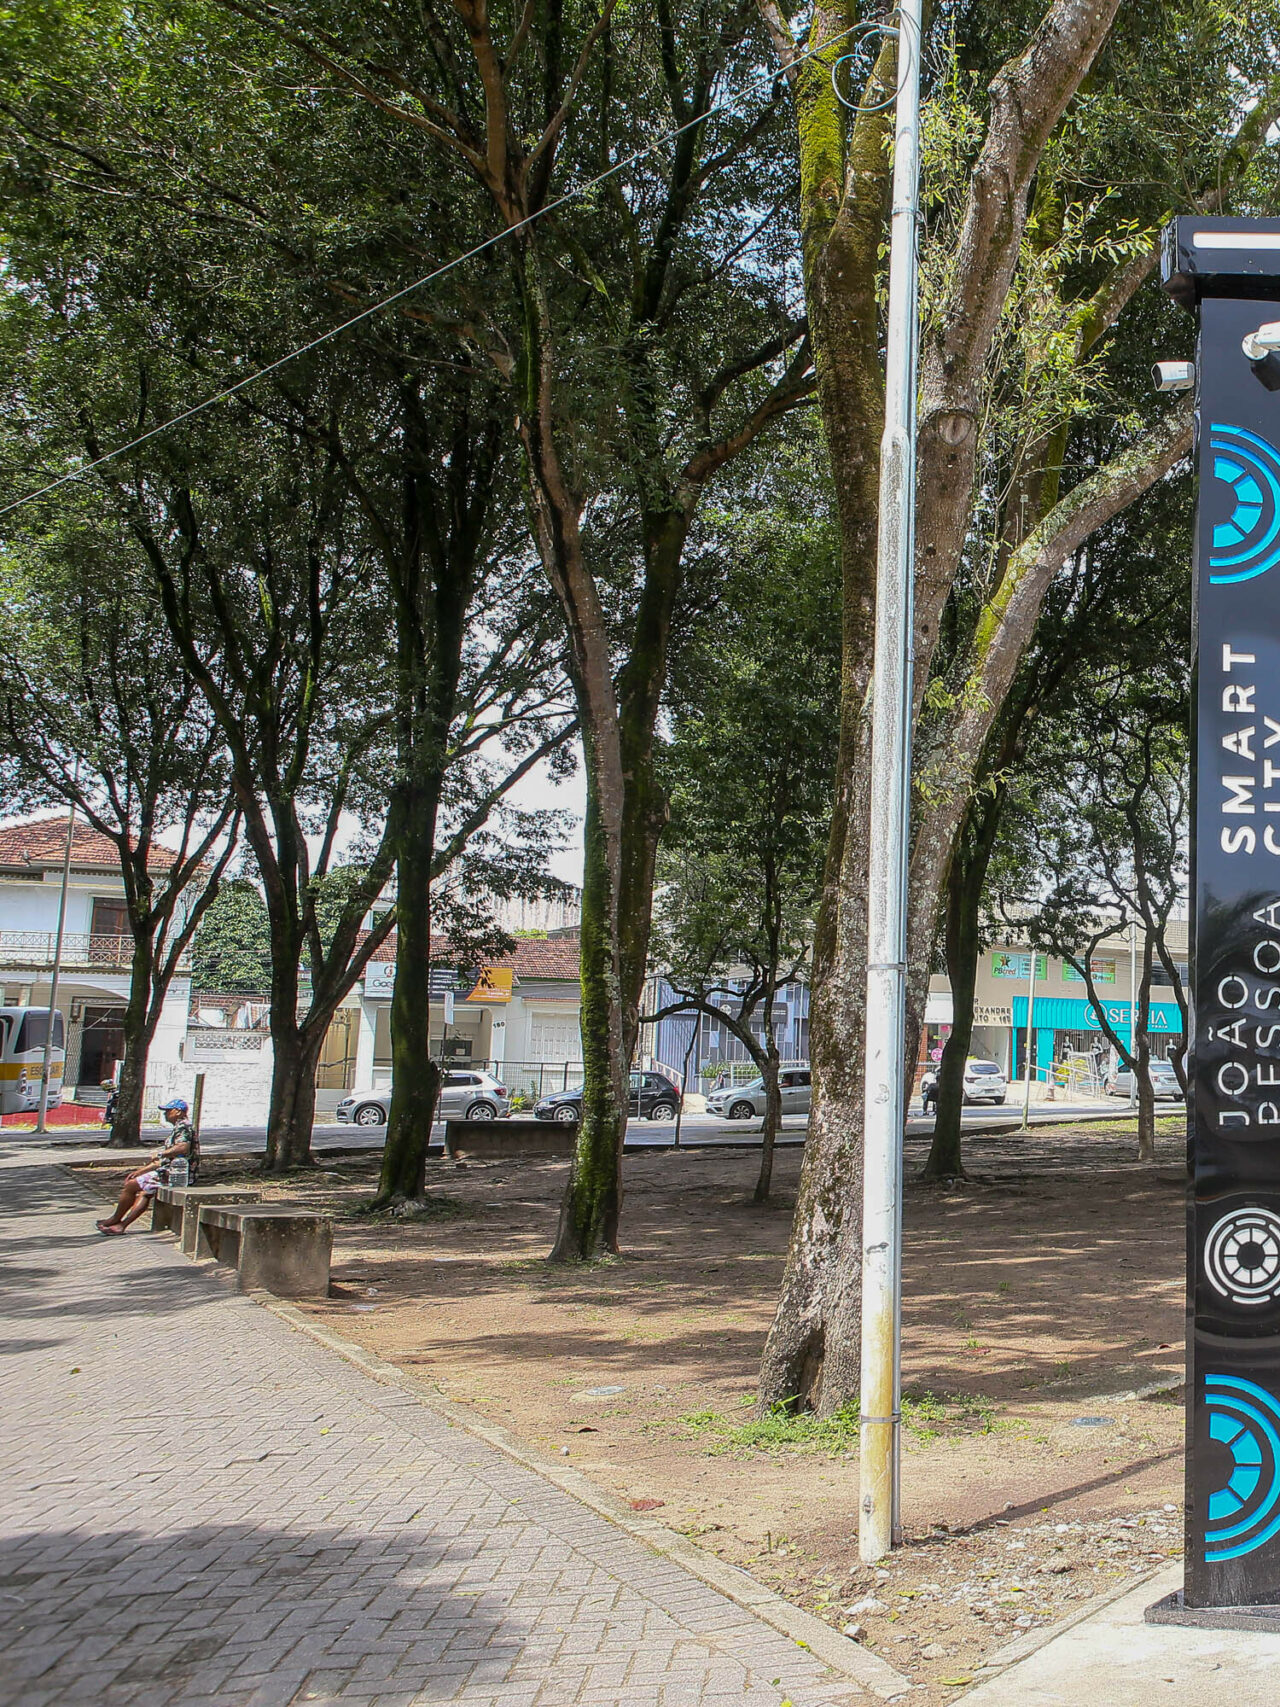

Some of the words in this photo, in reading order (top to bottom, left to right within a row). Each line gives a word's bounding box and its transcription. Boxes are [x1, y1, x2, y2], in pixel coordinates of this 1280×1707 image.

[1221, 643, 1256, 855] SMART
[974, 1006, 1012, 1015] EXANDRE
[1109, 1008, 1168, 1024] SERIA
[1208, 975, 1250, 1126] JOÃO
